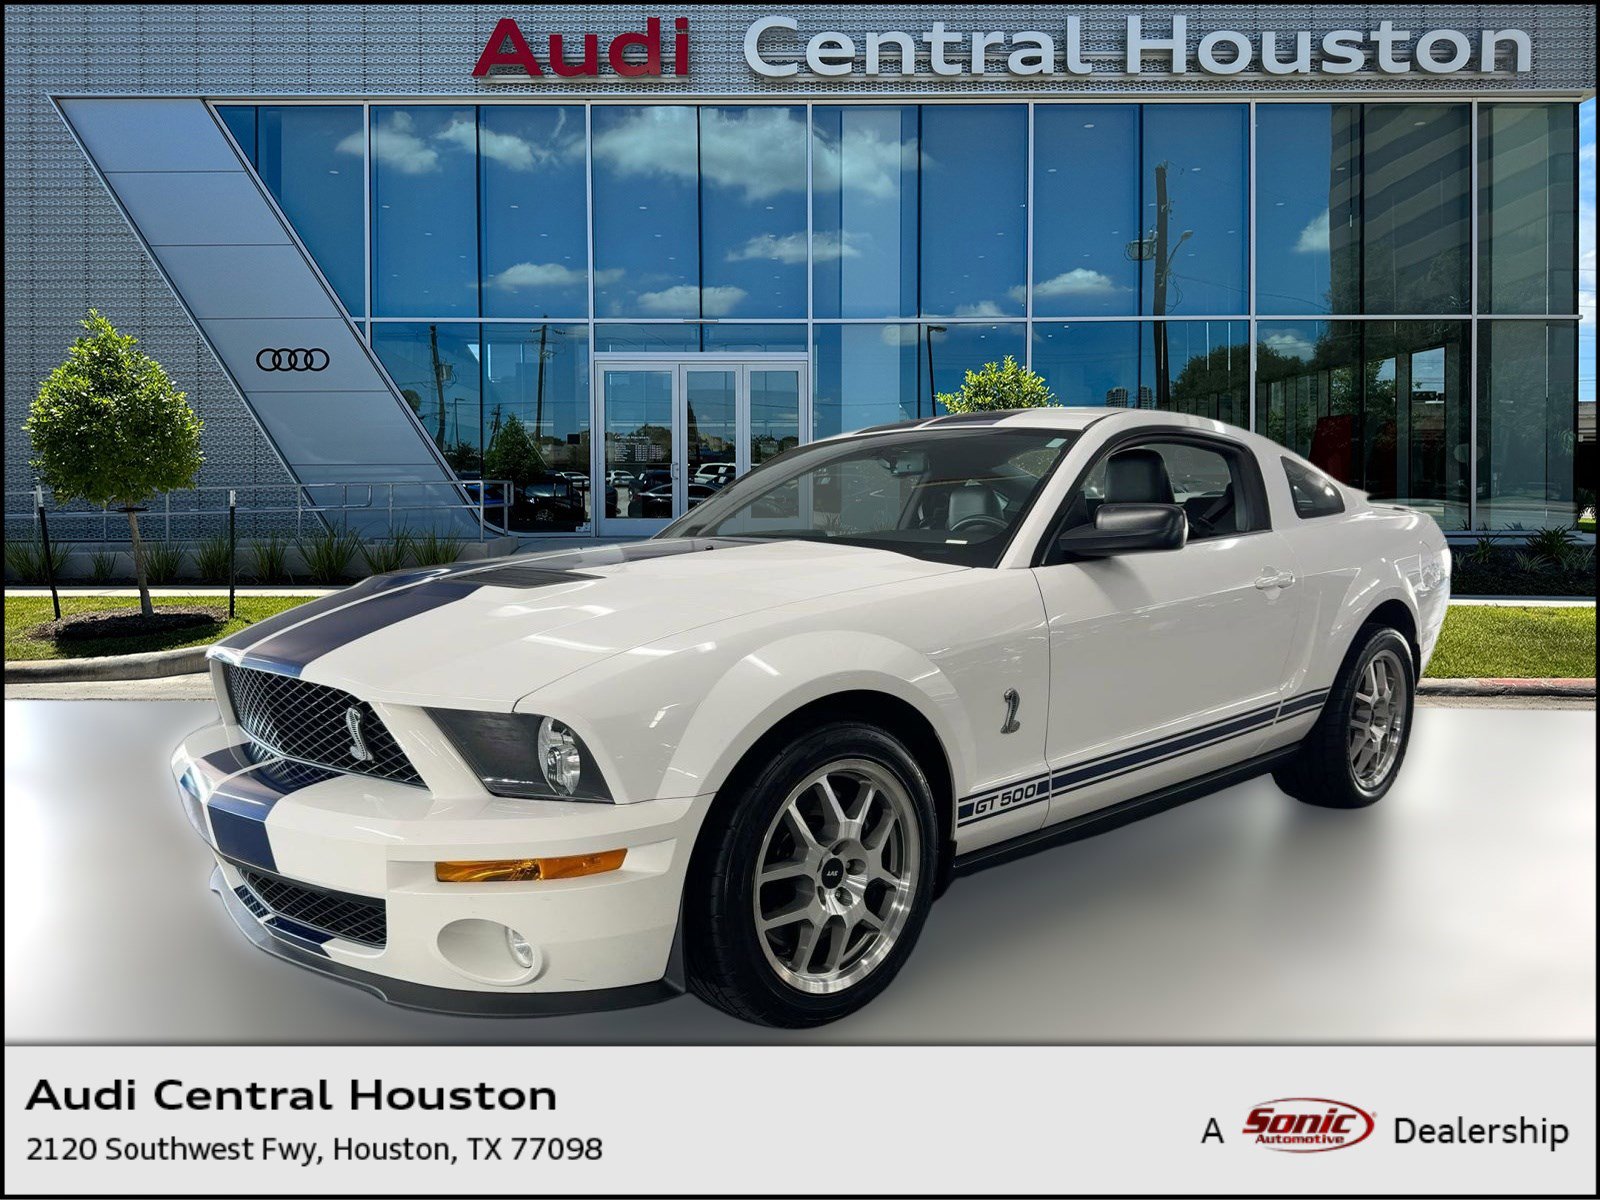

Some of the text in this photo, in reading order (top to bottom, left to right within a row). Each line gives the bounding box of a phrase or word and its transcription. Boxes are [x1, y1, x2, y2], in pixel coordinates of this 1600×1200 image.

[471, 15, 1532, 78] Audi Central Houston
[975, 784, 1037, 814] GT 500
